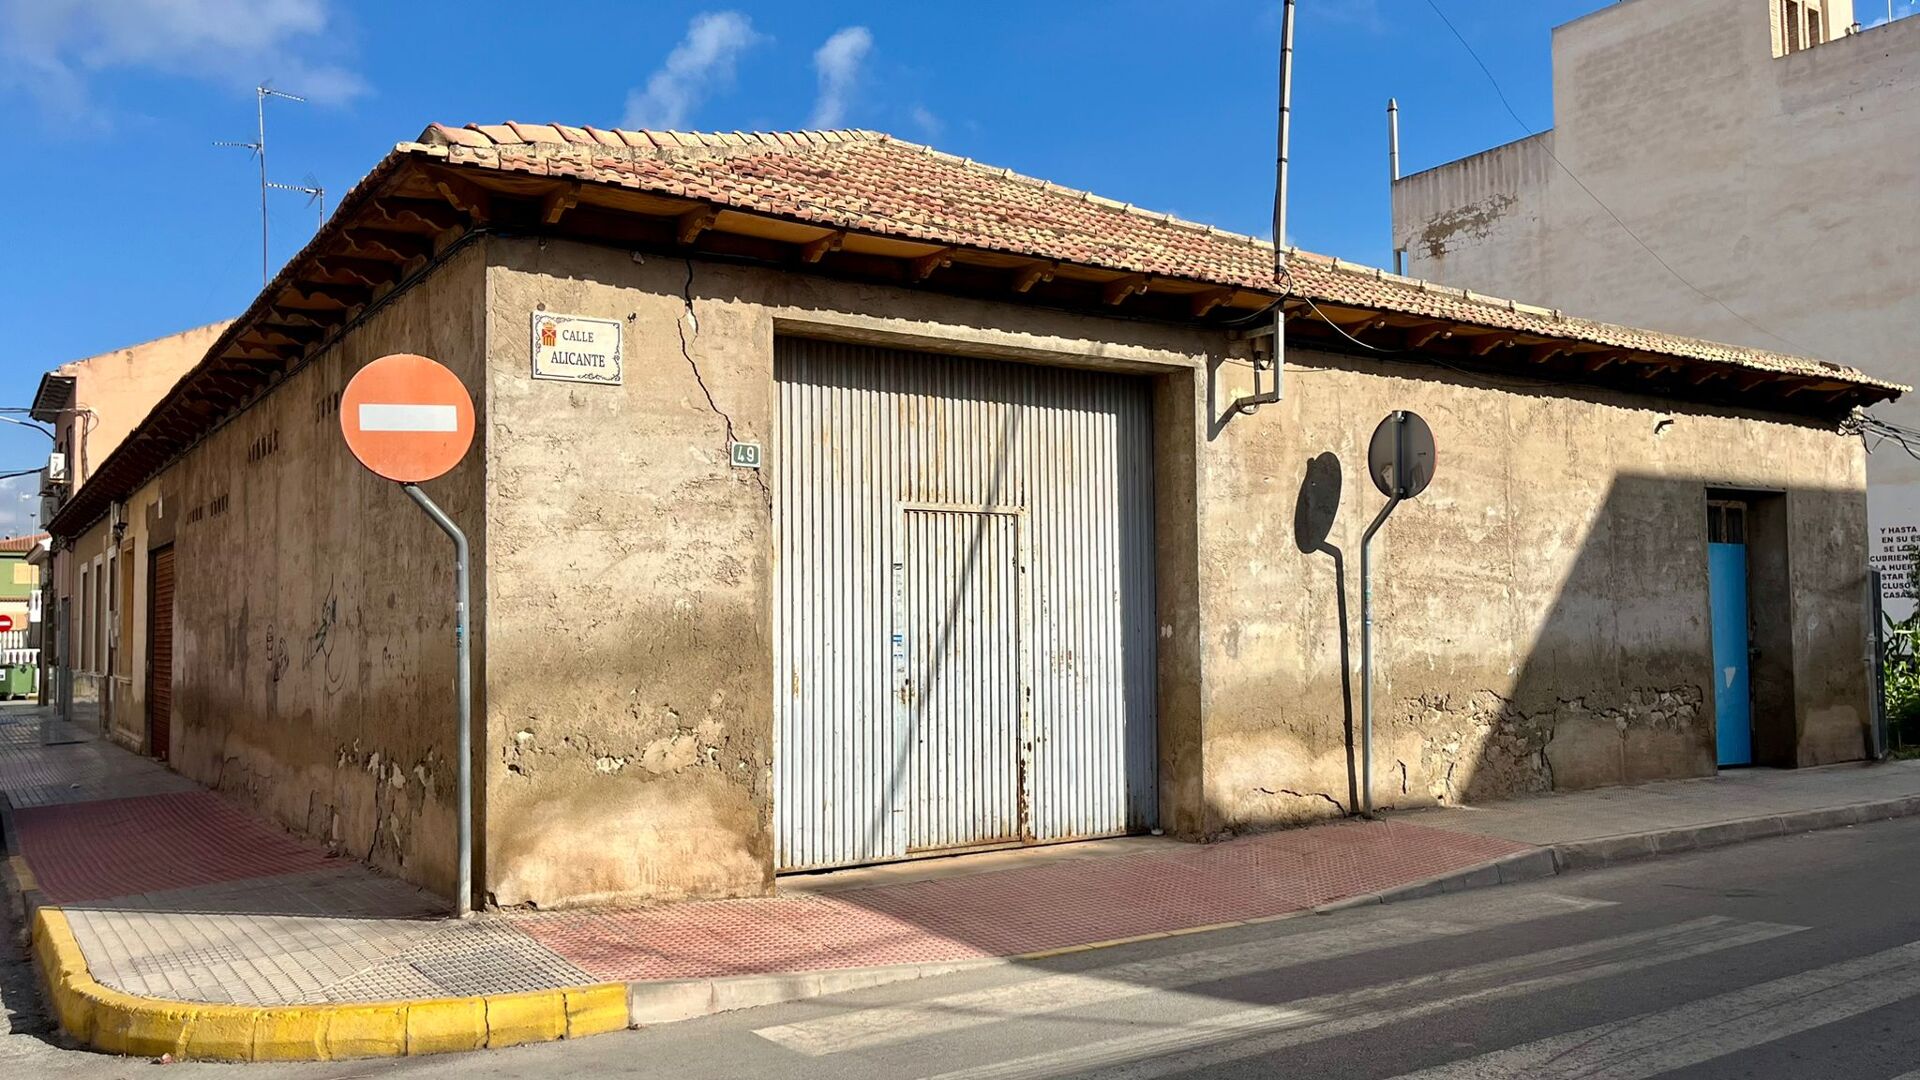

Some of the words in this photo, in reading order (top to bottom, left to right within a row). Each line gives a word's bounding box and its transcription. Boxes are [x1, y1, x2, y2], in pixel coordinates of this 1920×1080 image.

[562, 329, 594, 343] CALLE
[550, 351, 606, 368] ALICANTE
[737, 445, 755, 463] 49
[1896, 535, 1907, 543] SU
